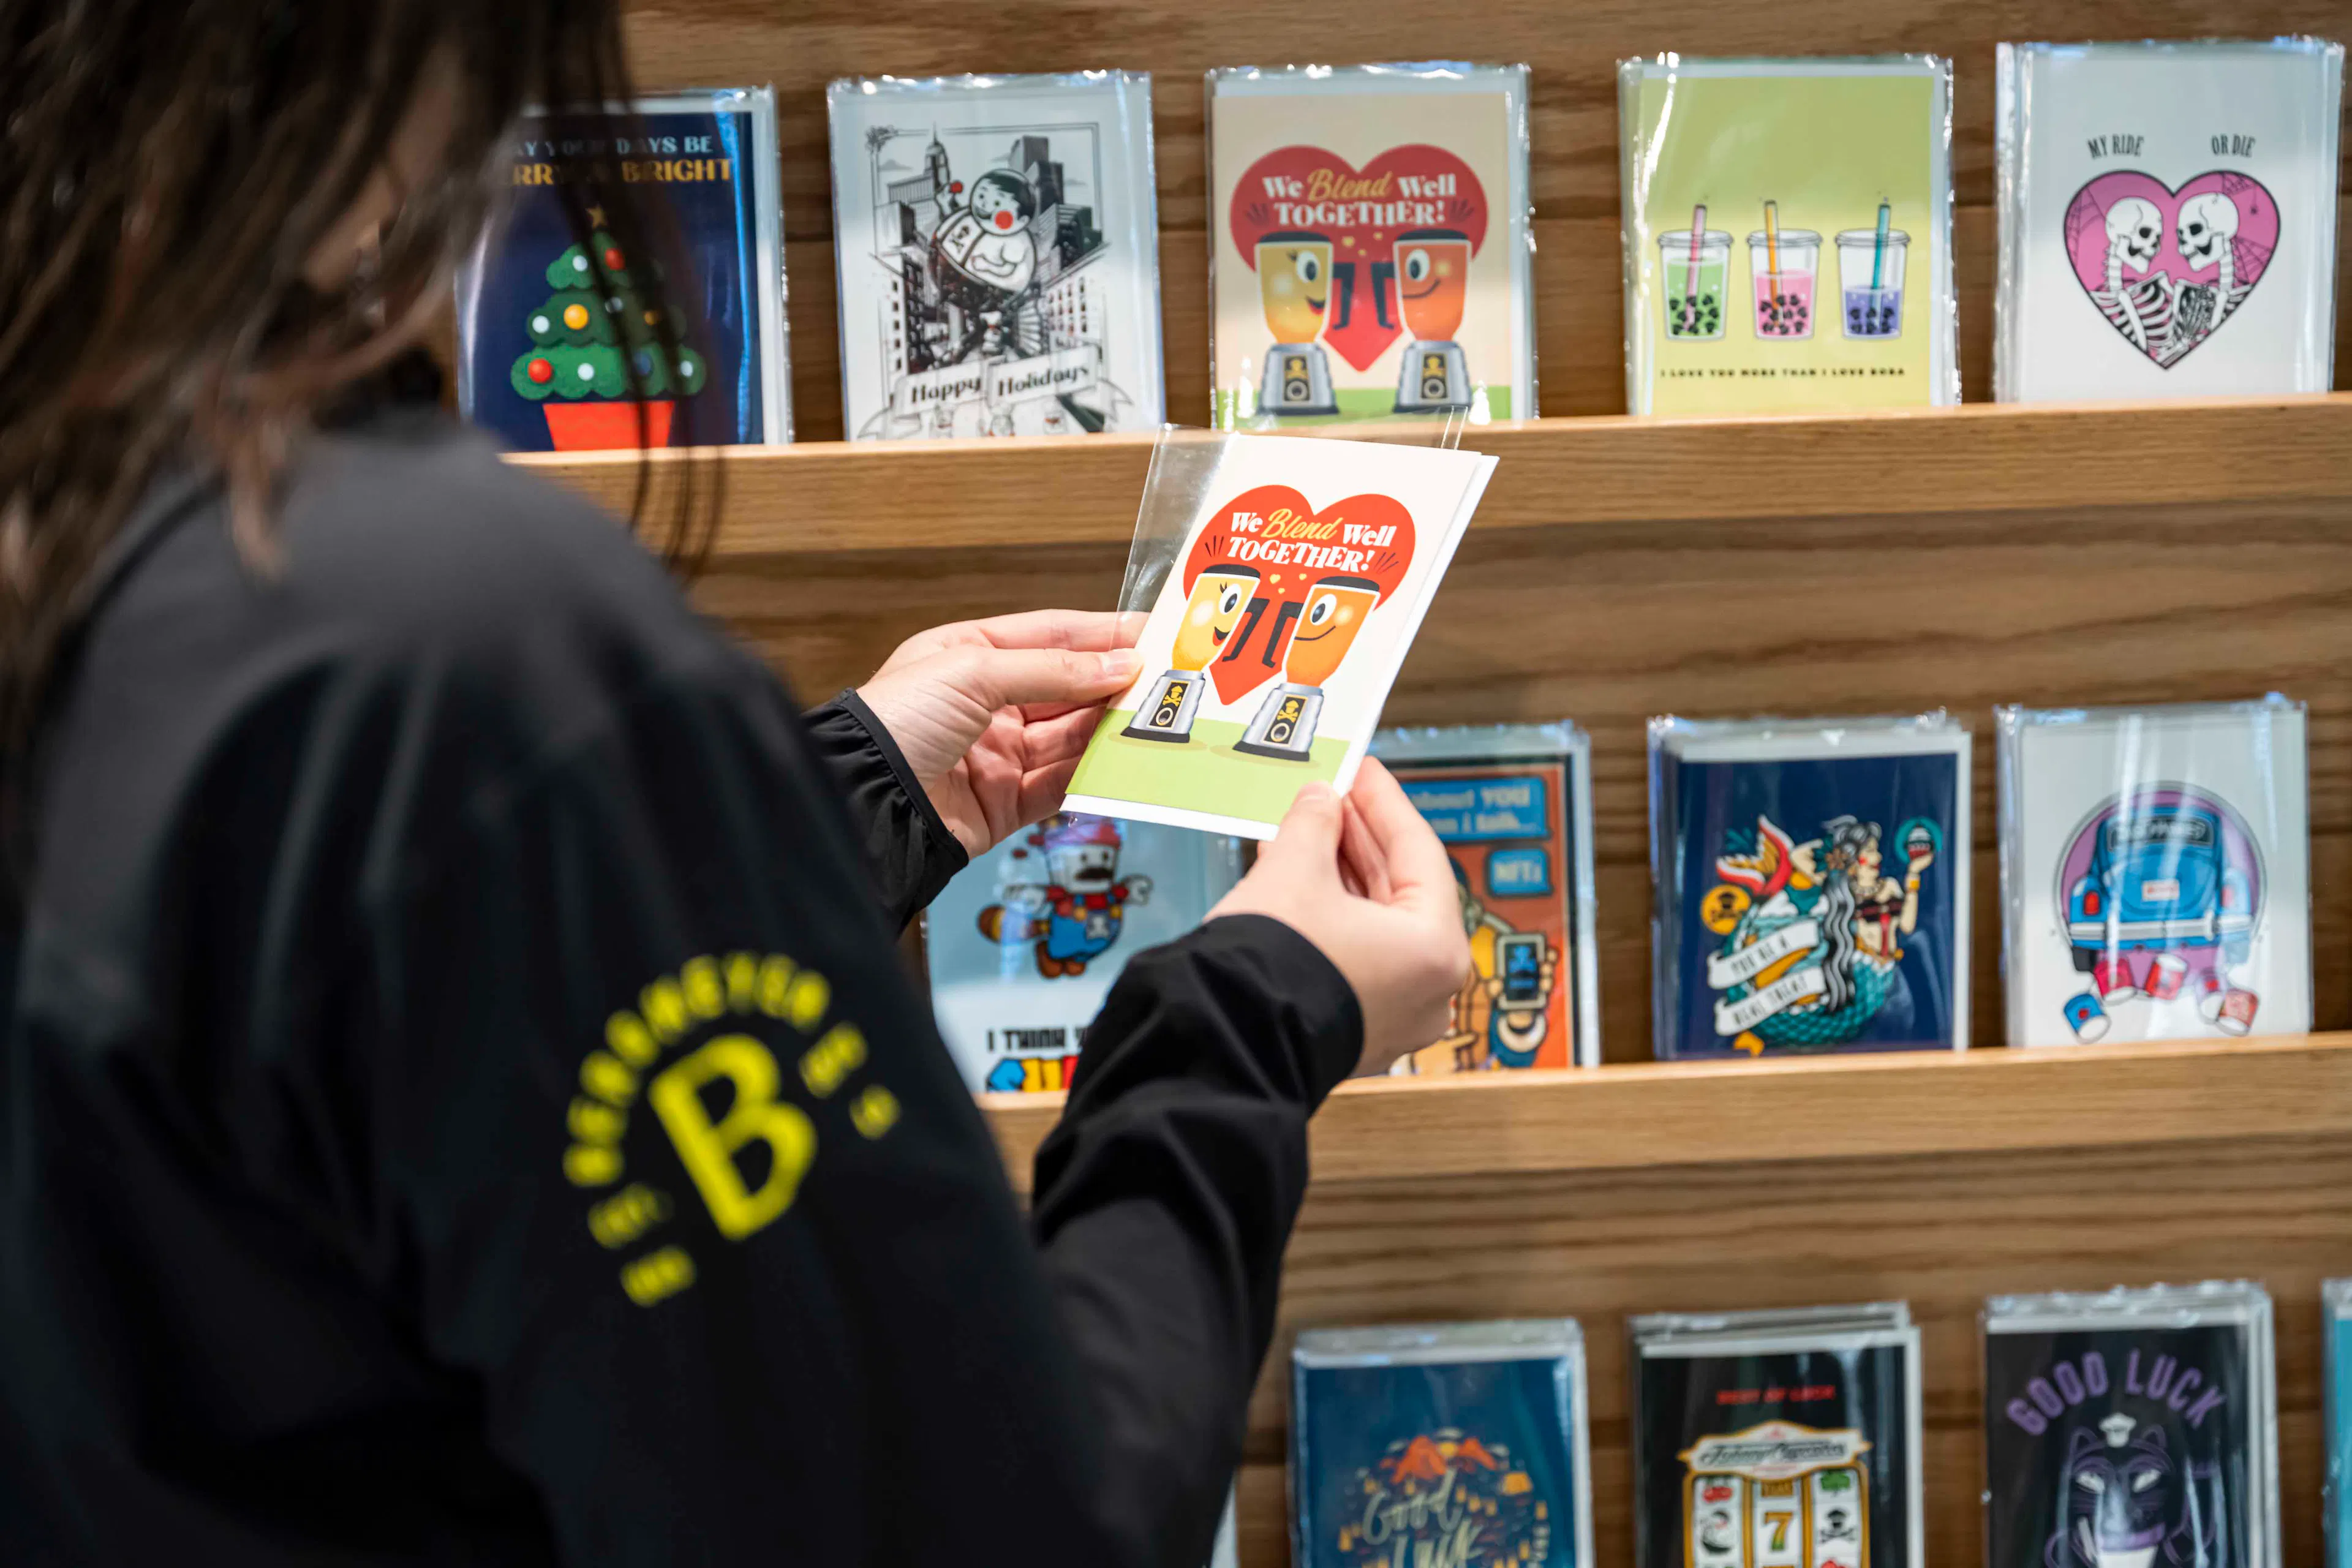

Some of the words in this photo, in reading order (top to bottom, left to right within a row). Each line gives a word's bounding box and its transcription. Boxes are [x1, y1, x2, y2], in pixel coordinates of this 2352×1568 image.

[683, 135, 714, 154] BE
[2087, 134, 2108, 159] MY
[2112, 134, 2144, 157] RIDE
[2211, 133, 2229, 156] OR
[2232, 134, 2256, 158] DIE
[620, 158, 735, 183] BRIGHT
[1262, 175, 1305, 198] We
[1306, 168, 1393, 202] Blend
[1397, 173, 1457, 197] Well
[1272, 201, 1447, 227] TOGETHER!
[912, 377, 980, 403] Happy
[998, 368, 1088, 397] Holidays
[1709, 368, 1735, 377] YOU
[1231, 512, 1263, 533] We
[1261, 508, 1343, 540] Blend
[1342, 523, 1397, 546] Well
[1227, 536, 1375, 573] TOGETHER!
[1480, 785, 1530, 809] YOU
[648, 1034, 818, 1241] B
[2006, 1351, 2109, 1436] GOOD
[2125, 1347, 2227, 1430] LUCK
[1362, 1468, 1464, 1545] Good
[1765, 1511, 1794, 1553] 7
